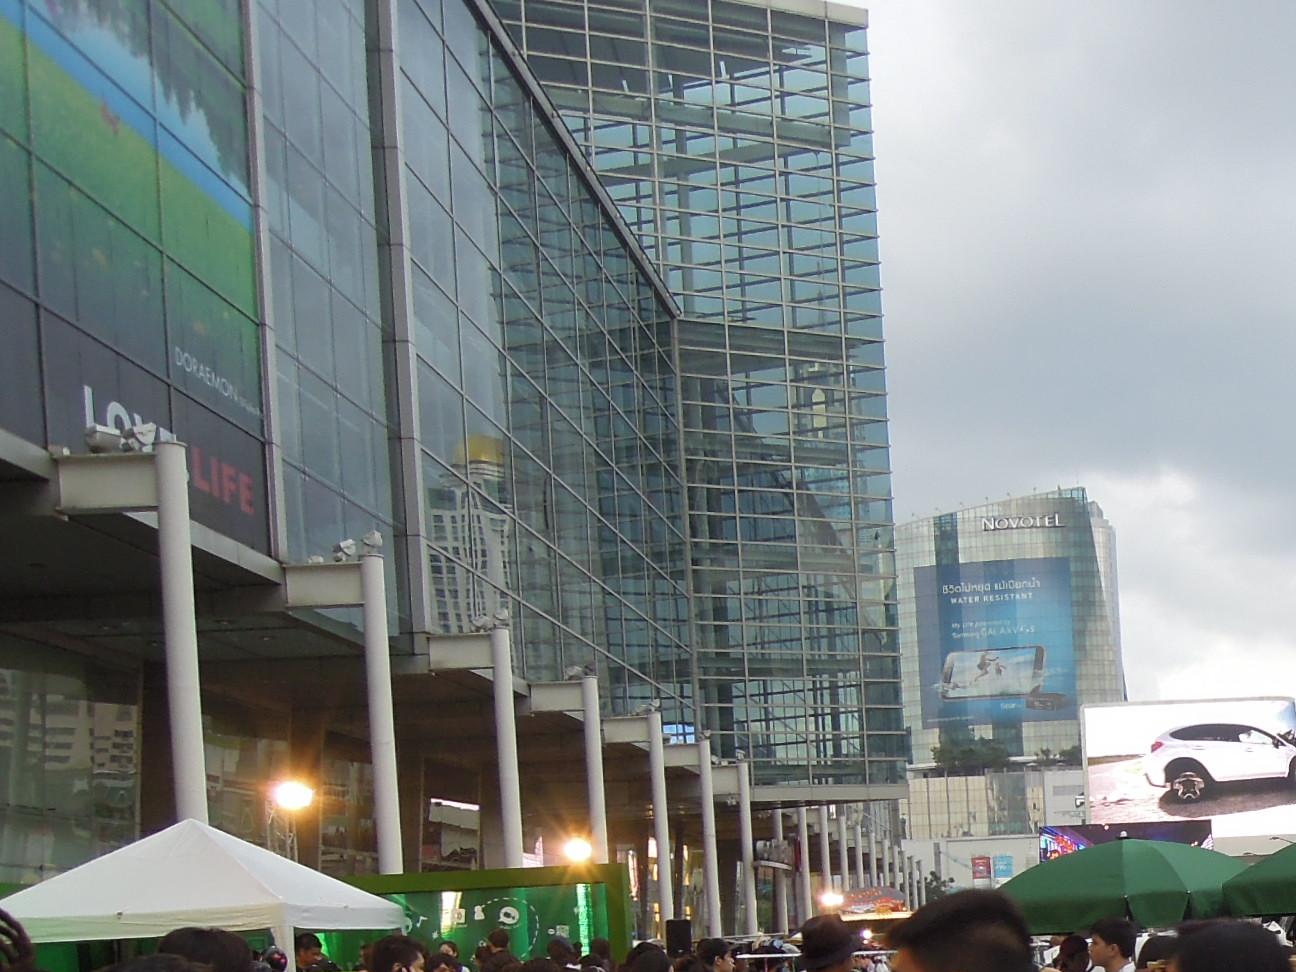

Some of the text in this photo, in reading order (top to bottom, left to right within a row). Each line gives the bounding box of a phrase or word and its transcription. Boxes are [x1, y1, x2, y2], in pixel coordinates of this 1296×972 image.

[174, 346, 238, 400] DORAEMON
[192, 448, 256, 515] LIFE
[982, 513, 1065, 531] NOVOTEL
[951, 592, 1033, 605] WATER RESISTANT
